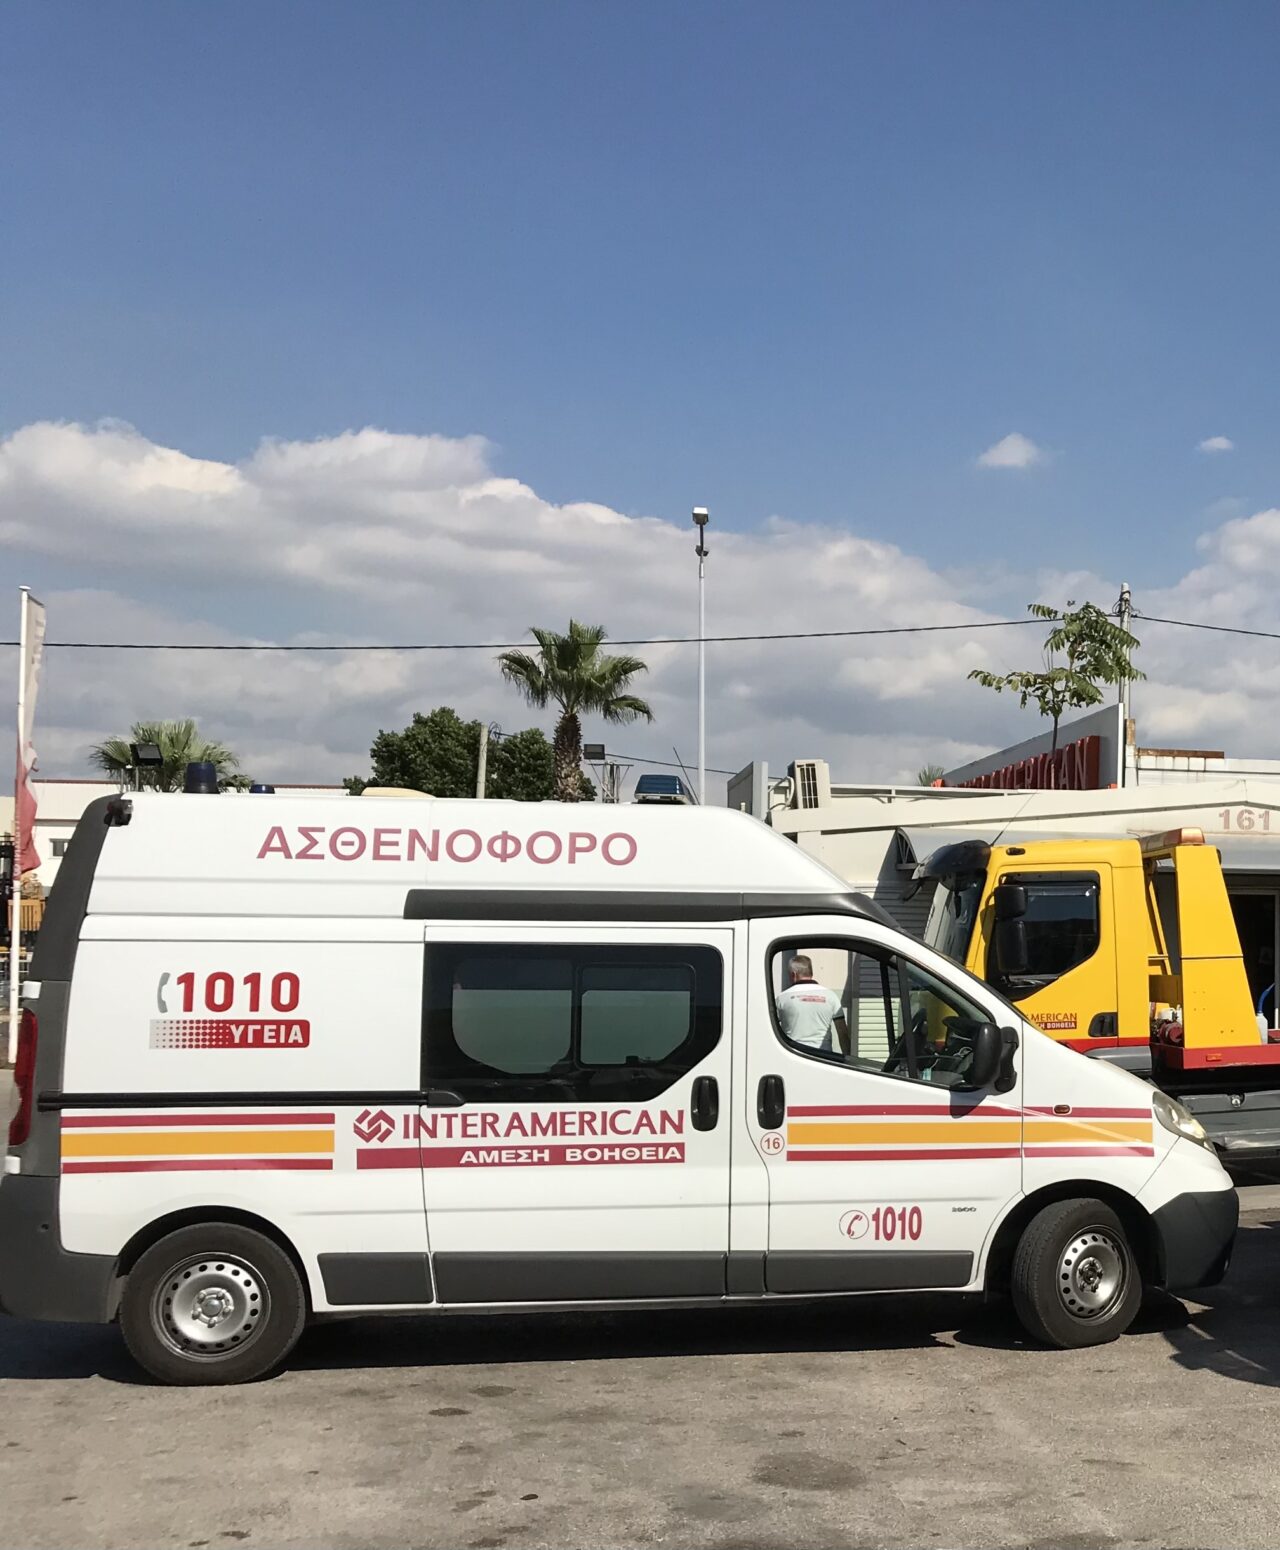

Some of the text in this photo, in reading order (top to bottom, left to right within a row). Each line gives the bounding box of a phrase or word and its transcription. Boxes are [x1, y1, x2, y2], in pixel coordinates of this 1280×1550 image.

[1218, 808, 1270, 831] 161
[256, 825, 638, 866] ΑΣΘΕΝΟΦΟΡΟ
[176, 971, 300, 1013] 1010
[1030, 1012, 1078, 1022] MERICAN
[229, 1024, 304, 1044] ΥΓΕΙΑ
[402, 1109, 685, 1140] INTERAMERICAN
[460, 1146, 682, 1164] ΑΜΕΣΗ ΒΟΗΘΕΙΑ
[764, 1137, 780, 1150] 16
[871, 1205, 923, 1241] 1010
